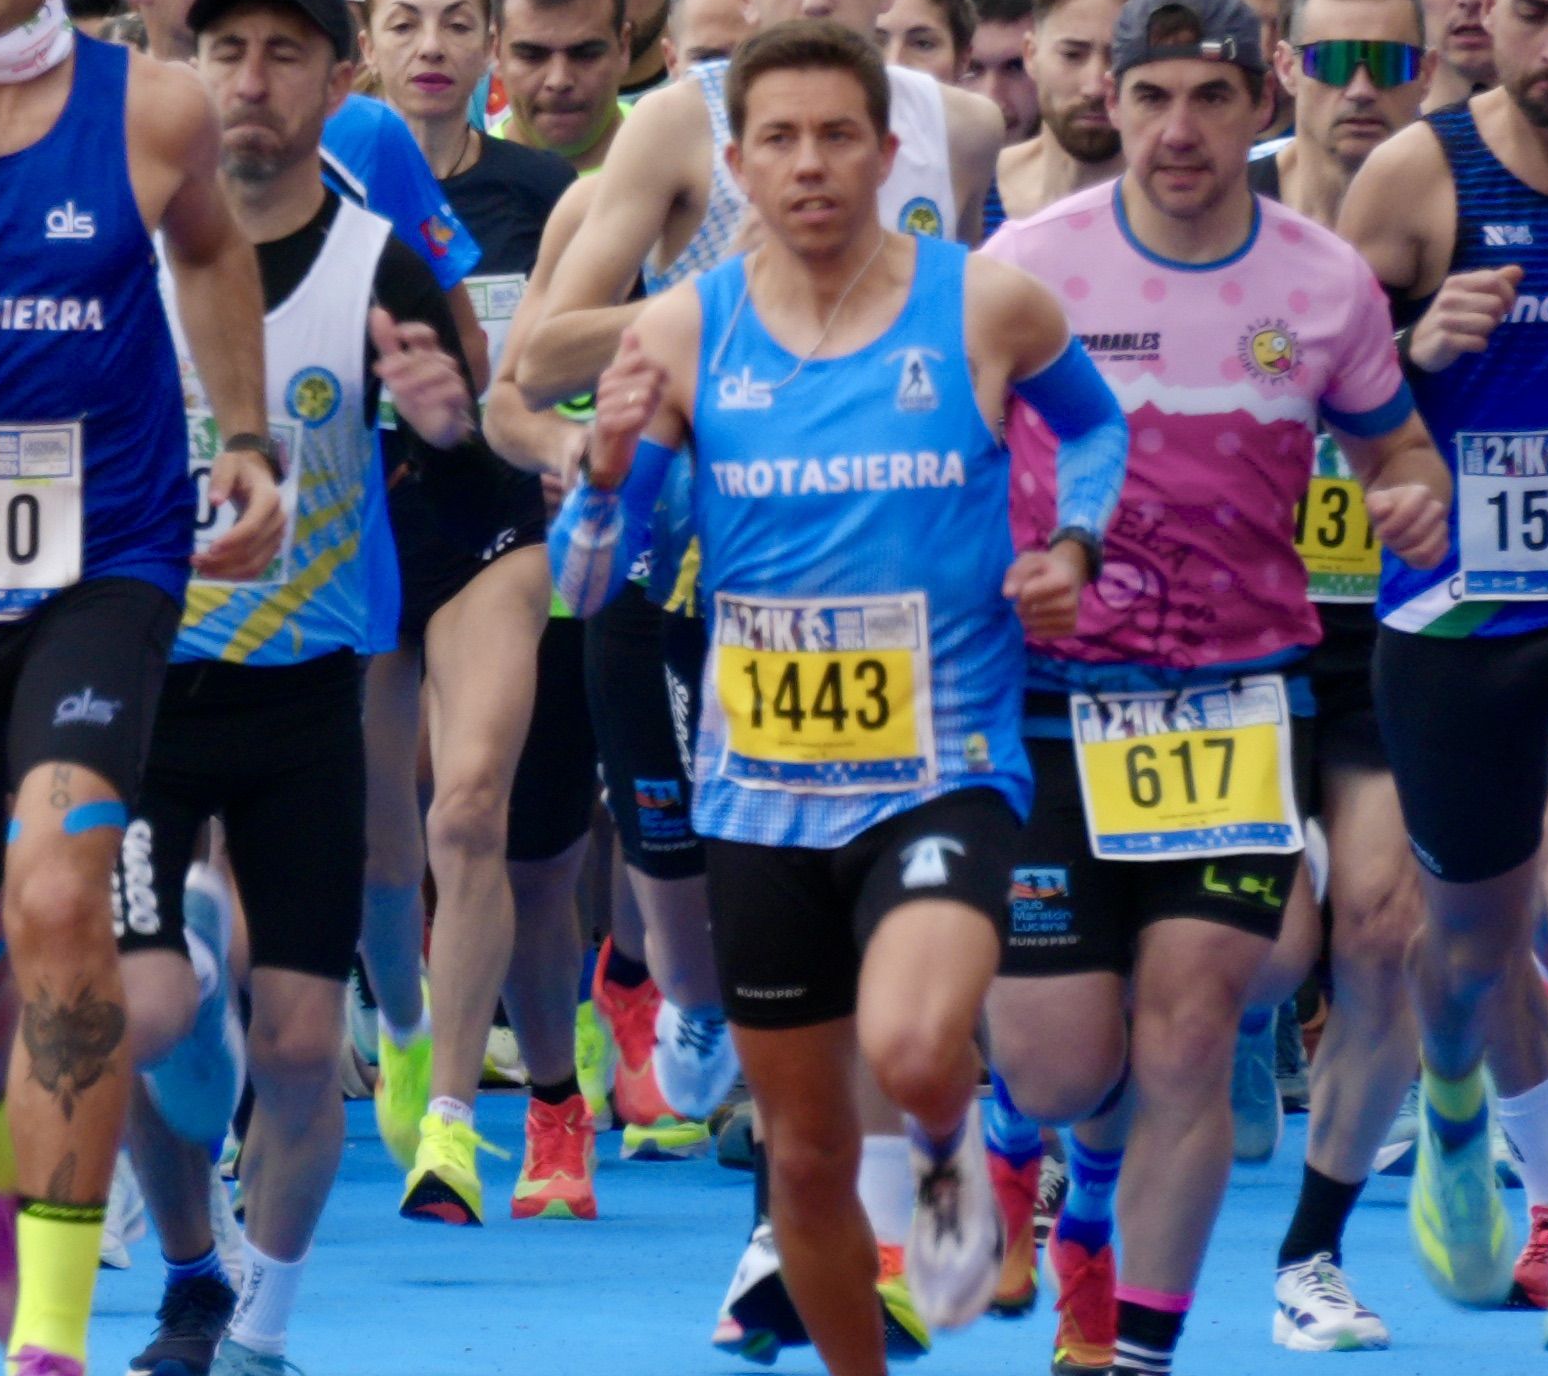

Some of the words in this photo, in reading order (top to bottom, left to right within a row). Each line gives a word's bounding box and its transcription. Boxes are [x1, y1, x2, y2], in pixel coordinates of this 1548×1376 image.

[712, 450, 966, 499] TROTASIERRA
[1485, 436, 1546, 475] 21K
[742, 657, 891, 734] 1443
[1106, 699, 1171, 740] 21K
[1126, 737, 1235, 809] 617
[1012, 899, 1045, 911] Club
[1012, 921, 1069, 933] Lucena
